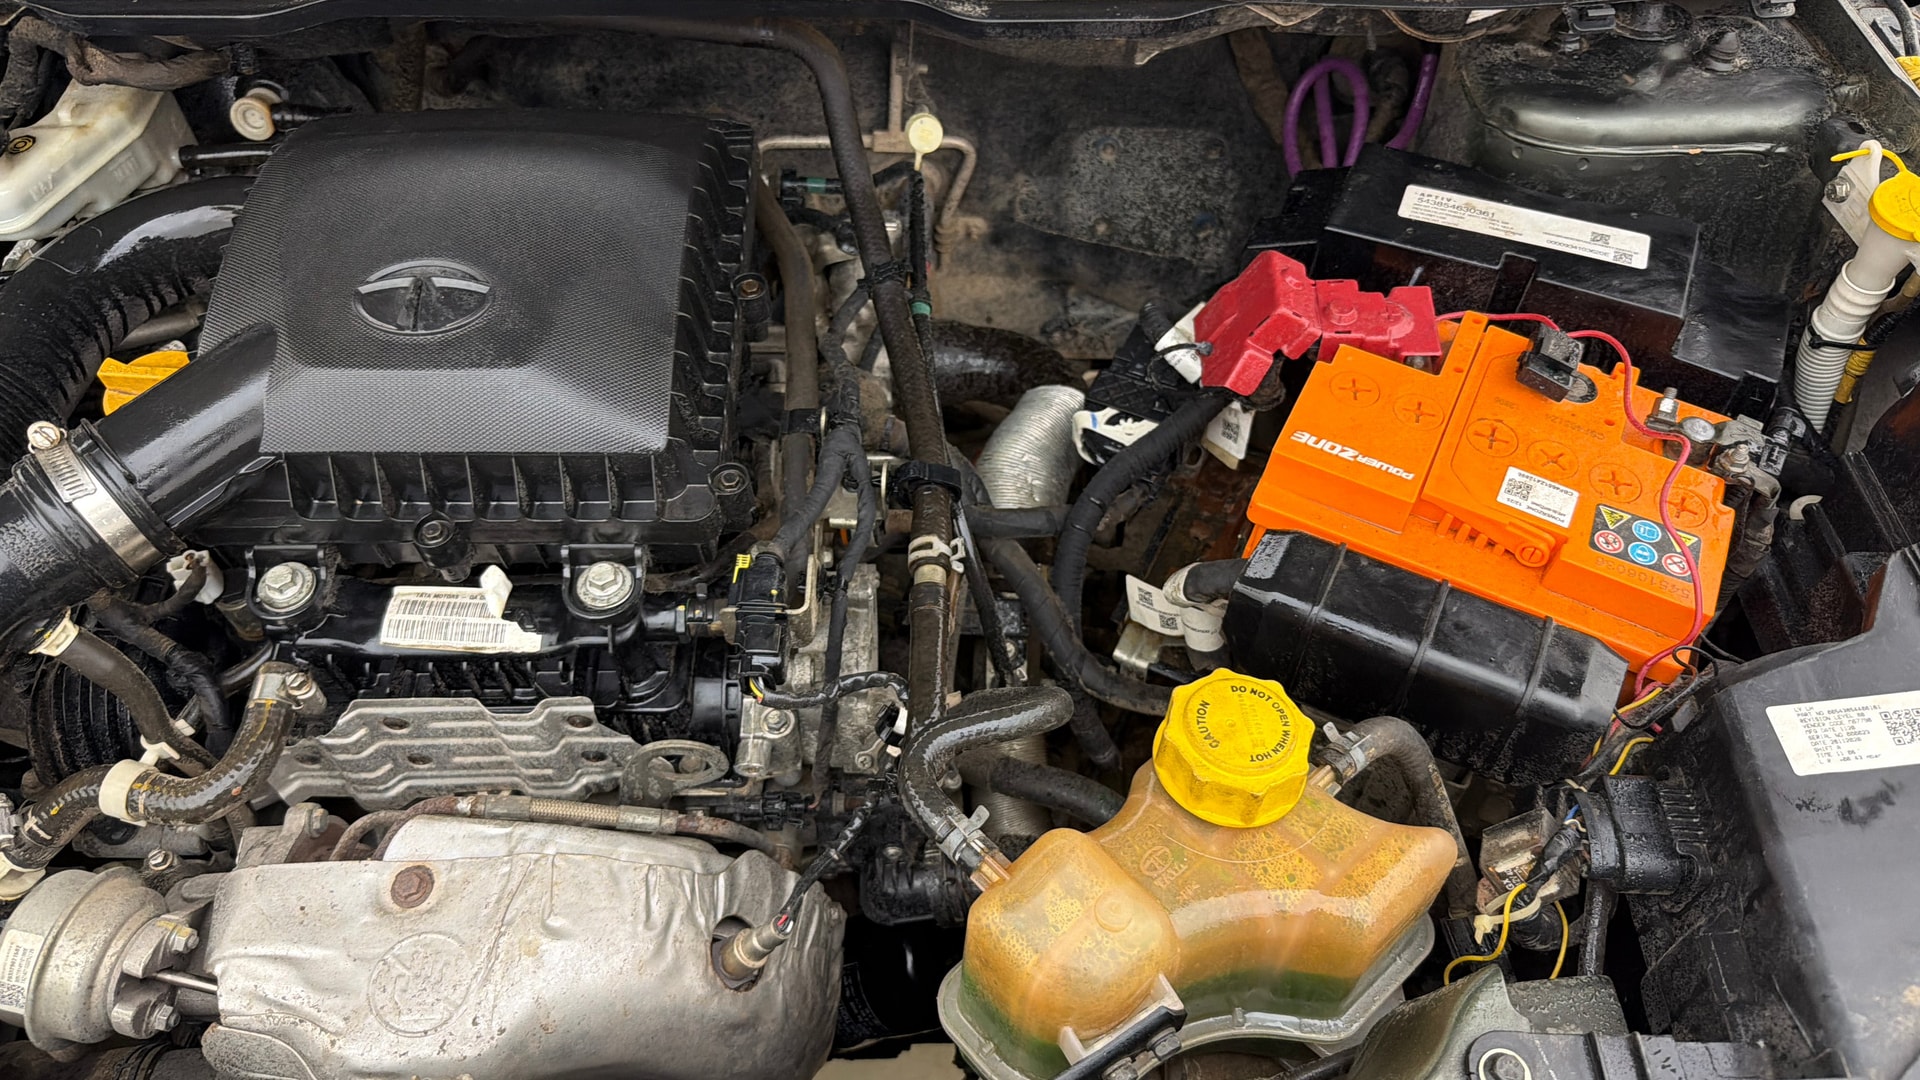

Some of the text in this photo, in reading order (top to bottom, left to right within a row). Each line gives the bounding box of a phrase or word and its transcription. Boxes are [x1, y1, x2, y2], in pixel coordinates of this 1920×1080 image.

[1290, 430, 1415, 480] POWERZONE
[1231, 685, 1247, 693] DO
[1250, 688, 1273, 702] NOT
[1196, 699, 1220, 749] CAUTION
[1271, 702, 1290, 727] OPEN
[1271, 730, 1291, 755] WHEN
[1249, 751, 1273, 762] HOT
